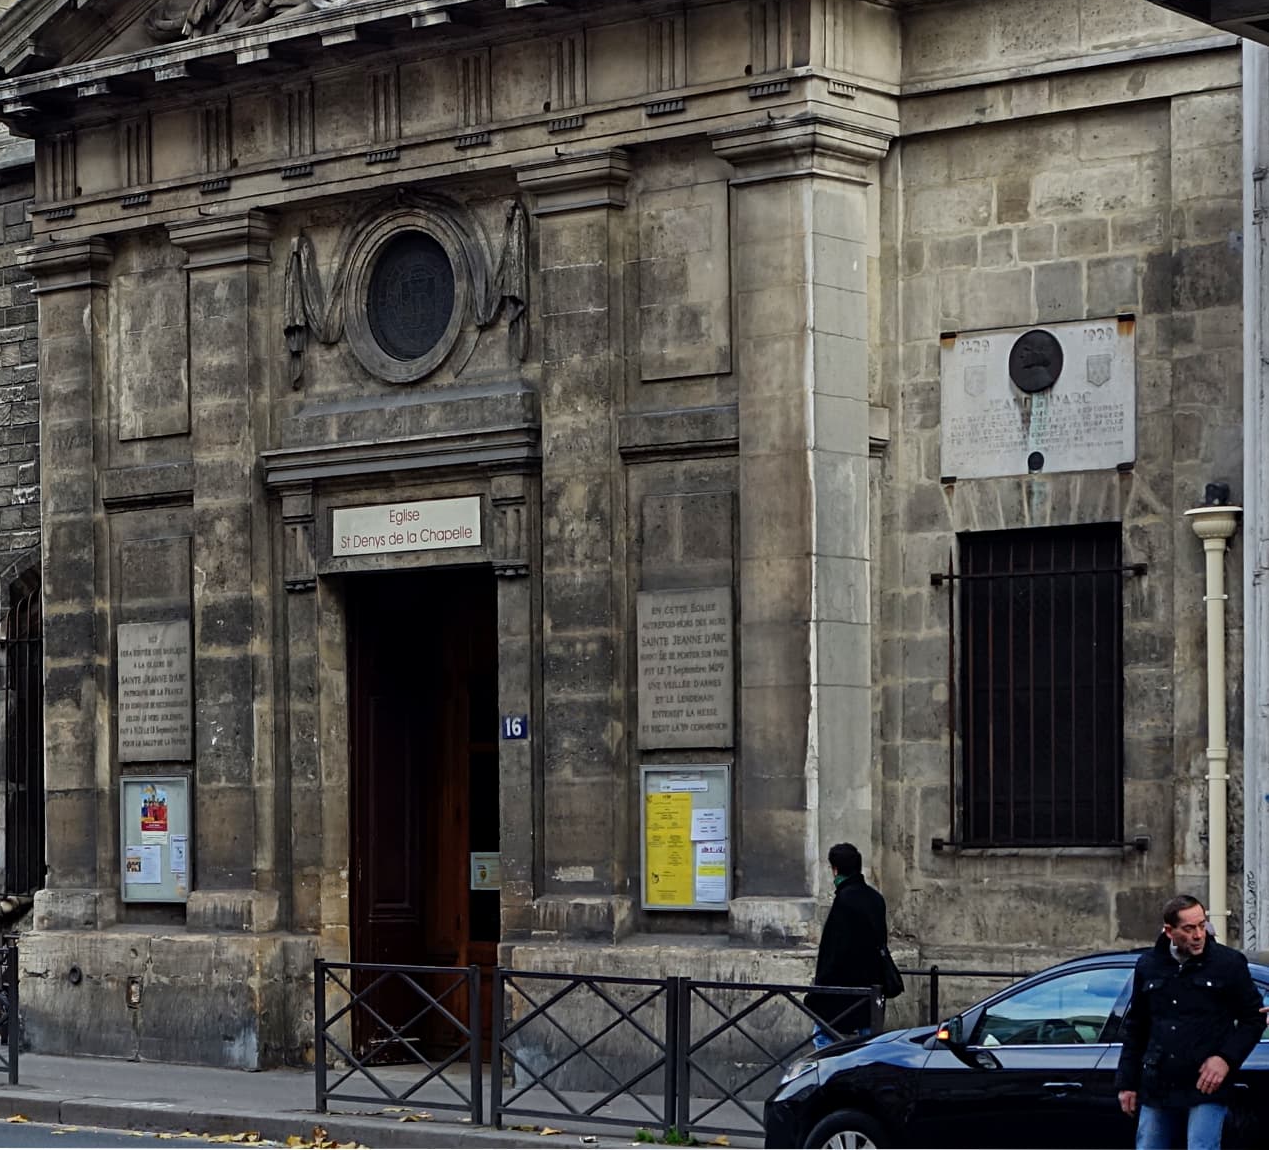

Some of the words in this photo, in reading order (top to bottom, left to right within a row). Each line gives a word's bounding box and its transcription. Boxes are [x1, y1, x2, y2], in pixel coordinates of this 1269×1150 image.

[389, 509, 420, 525] Eglise
[341, 536, 351, 549] St
[353, 534, 385, 549] Denys
[389, 532, 404, 545] de
[406, 530, 416, 543] la
[420, 526, 473, 543] Chapelle
[641, 636, 668, 646] SAINTE
[672, 635, 703, 646] JEANNE
[506, 717, 522, 736] 16
